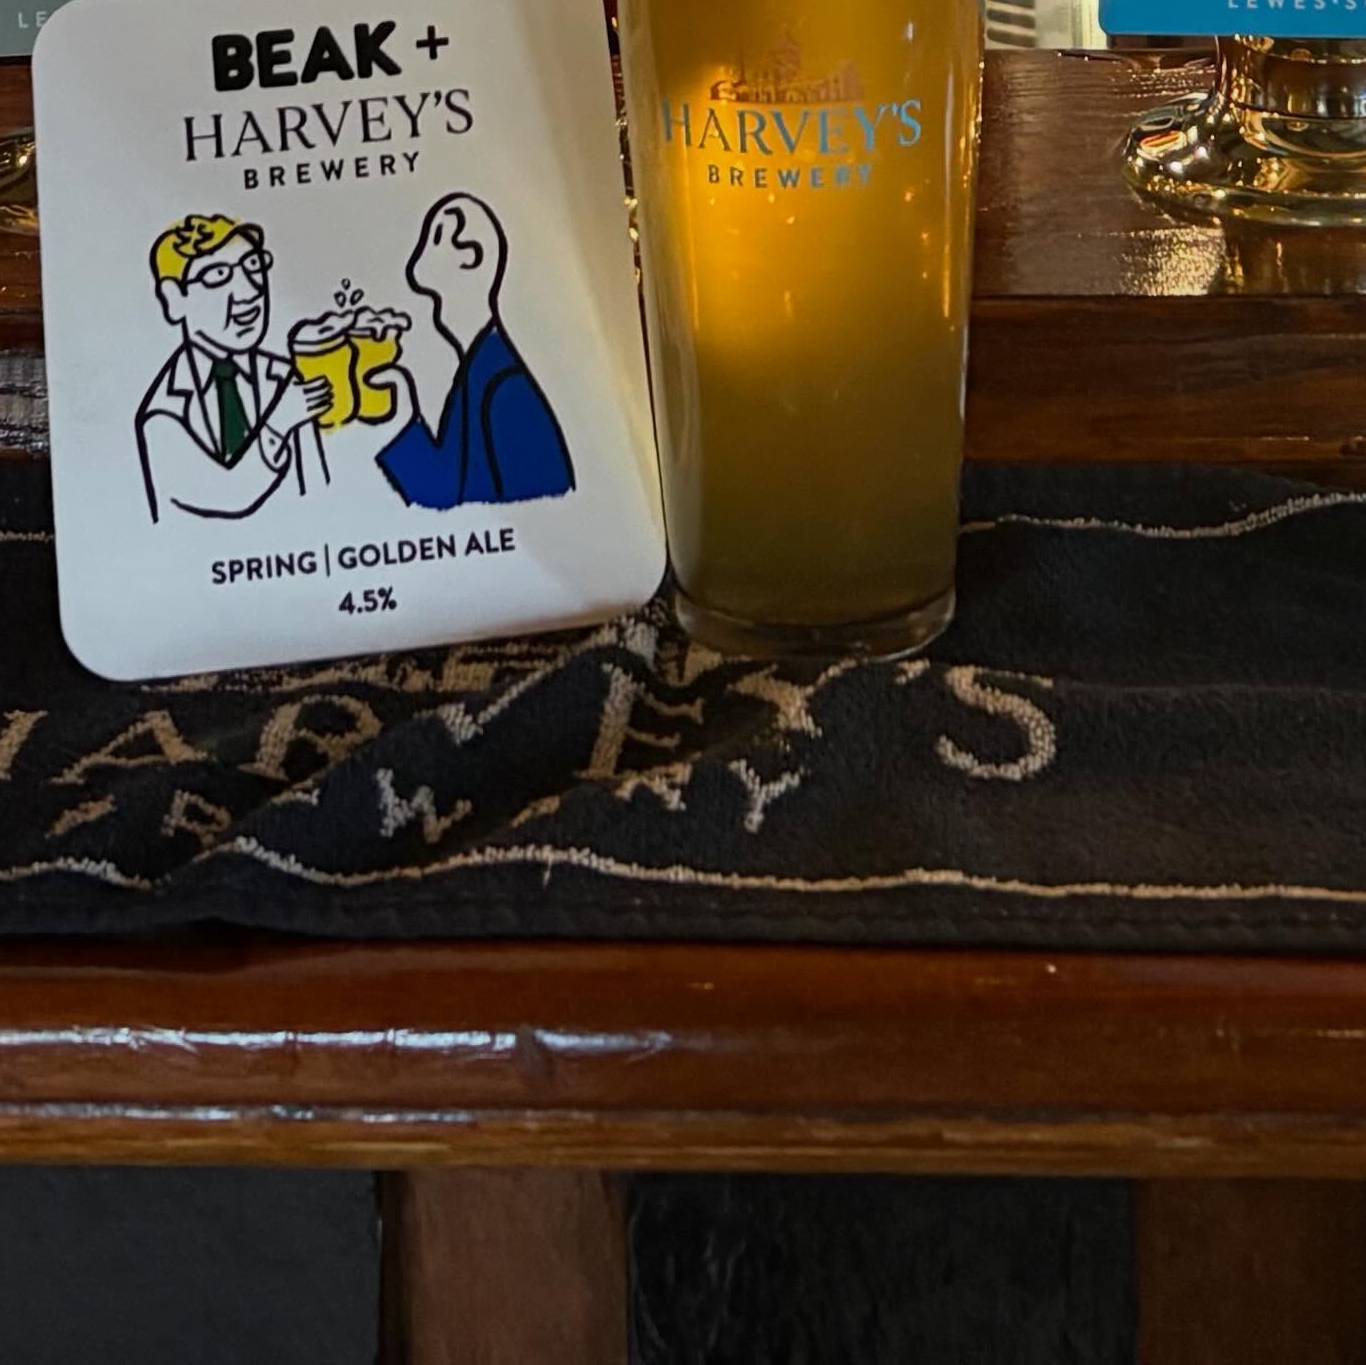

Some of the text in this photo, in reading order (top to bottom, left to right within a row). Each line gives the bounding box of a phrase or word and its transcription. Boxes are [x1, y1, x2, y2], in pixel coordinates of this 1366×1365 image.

[210, 21, 402, 92] BEAK
[183, 88, 475, 162] HARVEY'S
[659, 99, 924, 156] HARVEY'S
[243, 150, 422, 190] BREWERY
[707, 163, 872, 189] BREWERY
[211, 528, 517, 585] SPRING GOLDEN ALE
[338, 586, 398, 616] 4.5%
